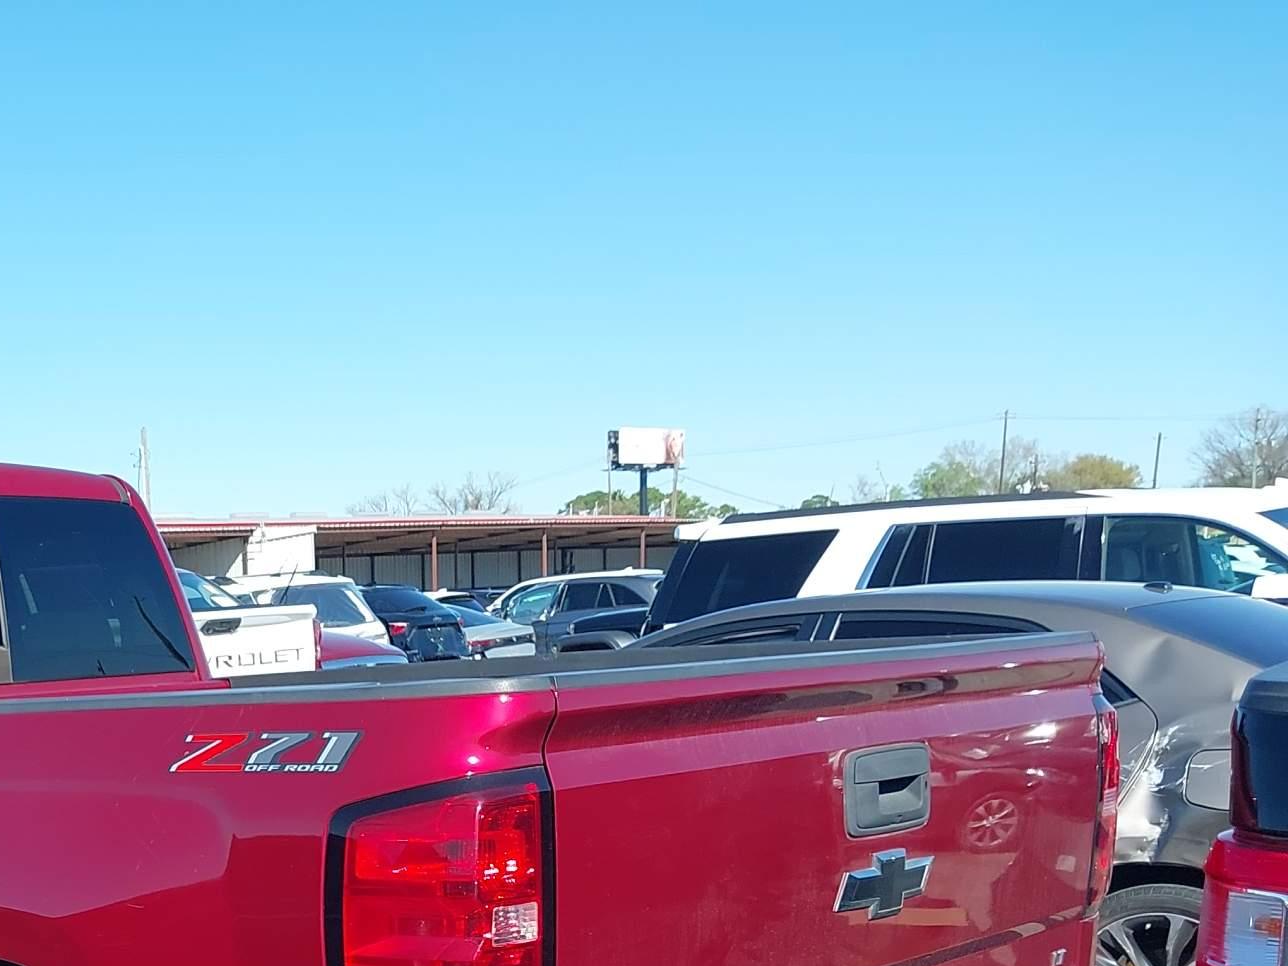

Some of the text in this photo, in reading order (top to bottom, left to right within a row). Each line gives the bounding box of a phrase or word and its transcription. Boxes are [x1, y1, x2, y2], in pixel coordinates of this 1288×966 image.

[169, 732, 361, 773] Z71
[244, 764, 339, 772] OFF ROAD
